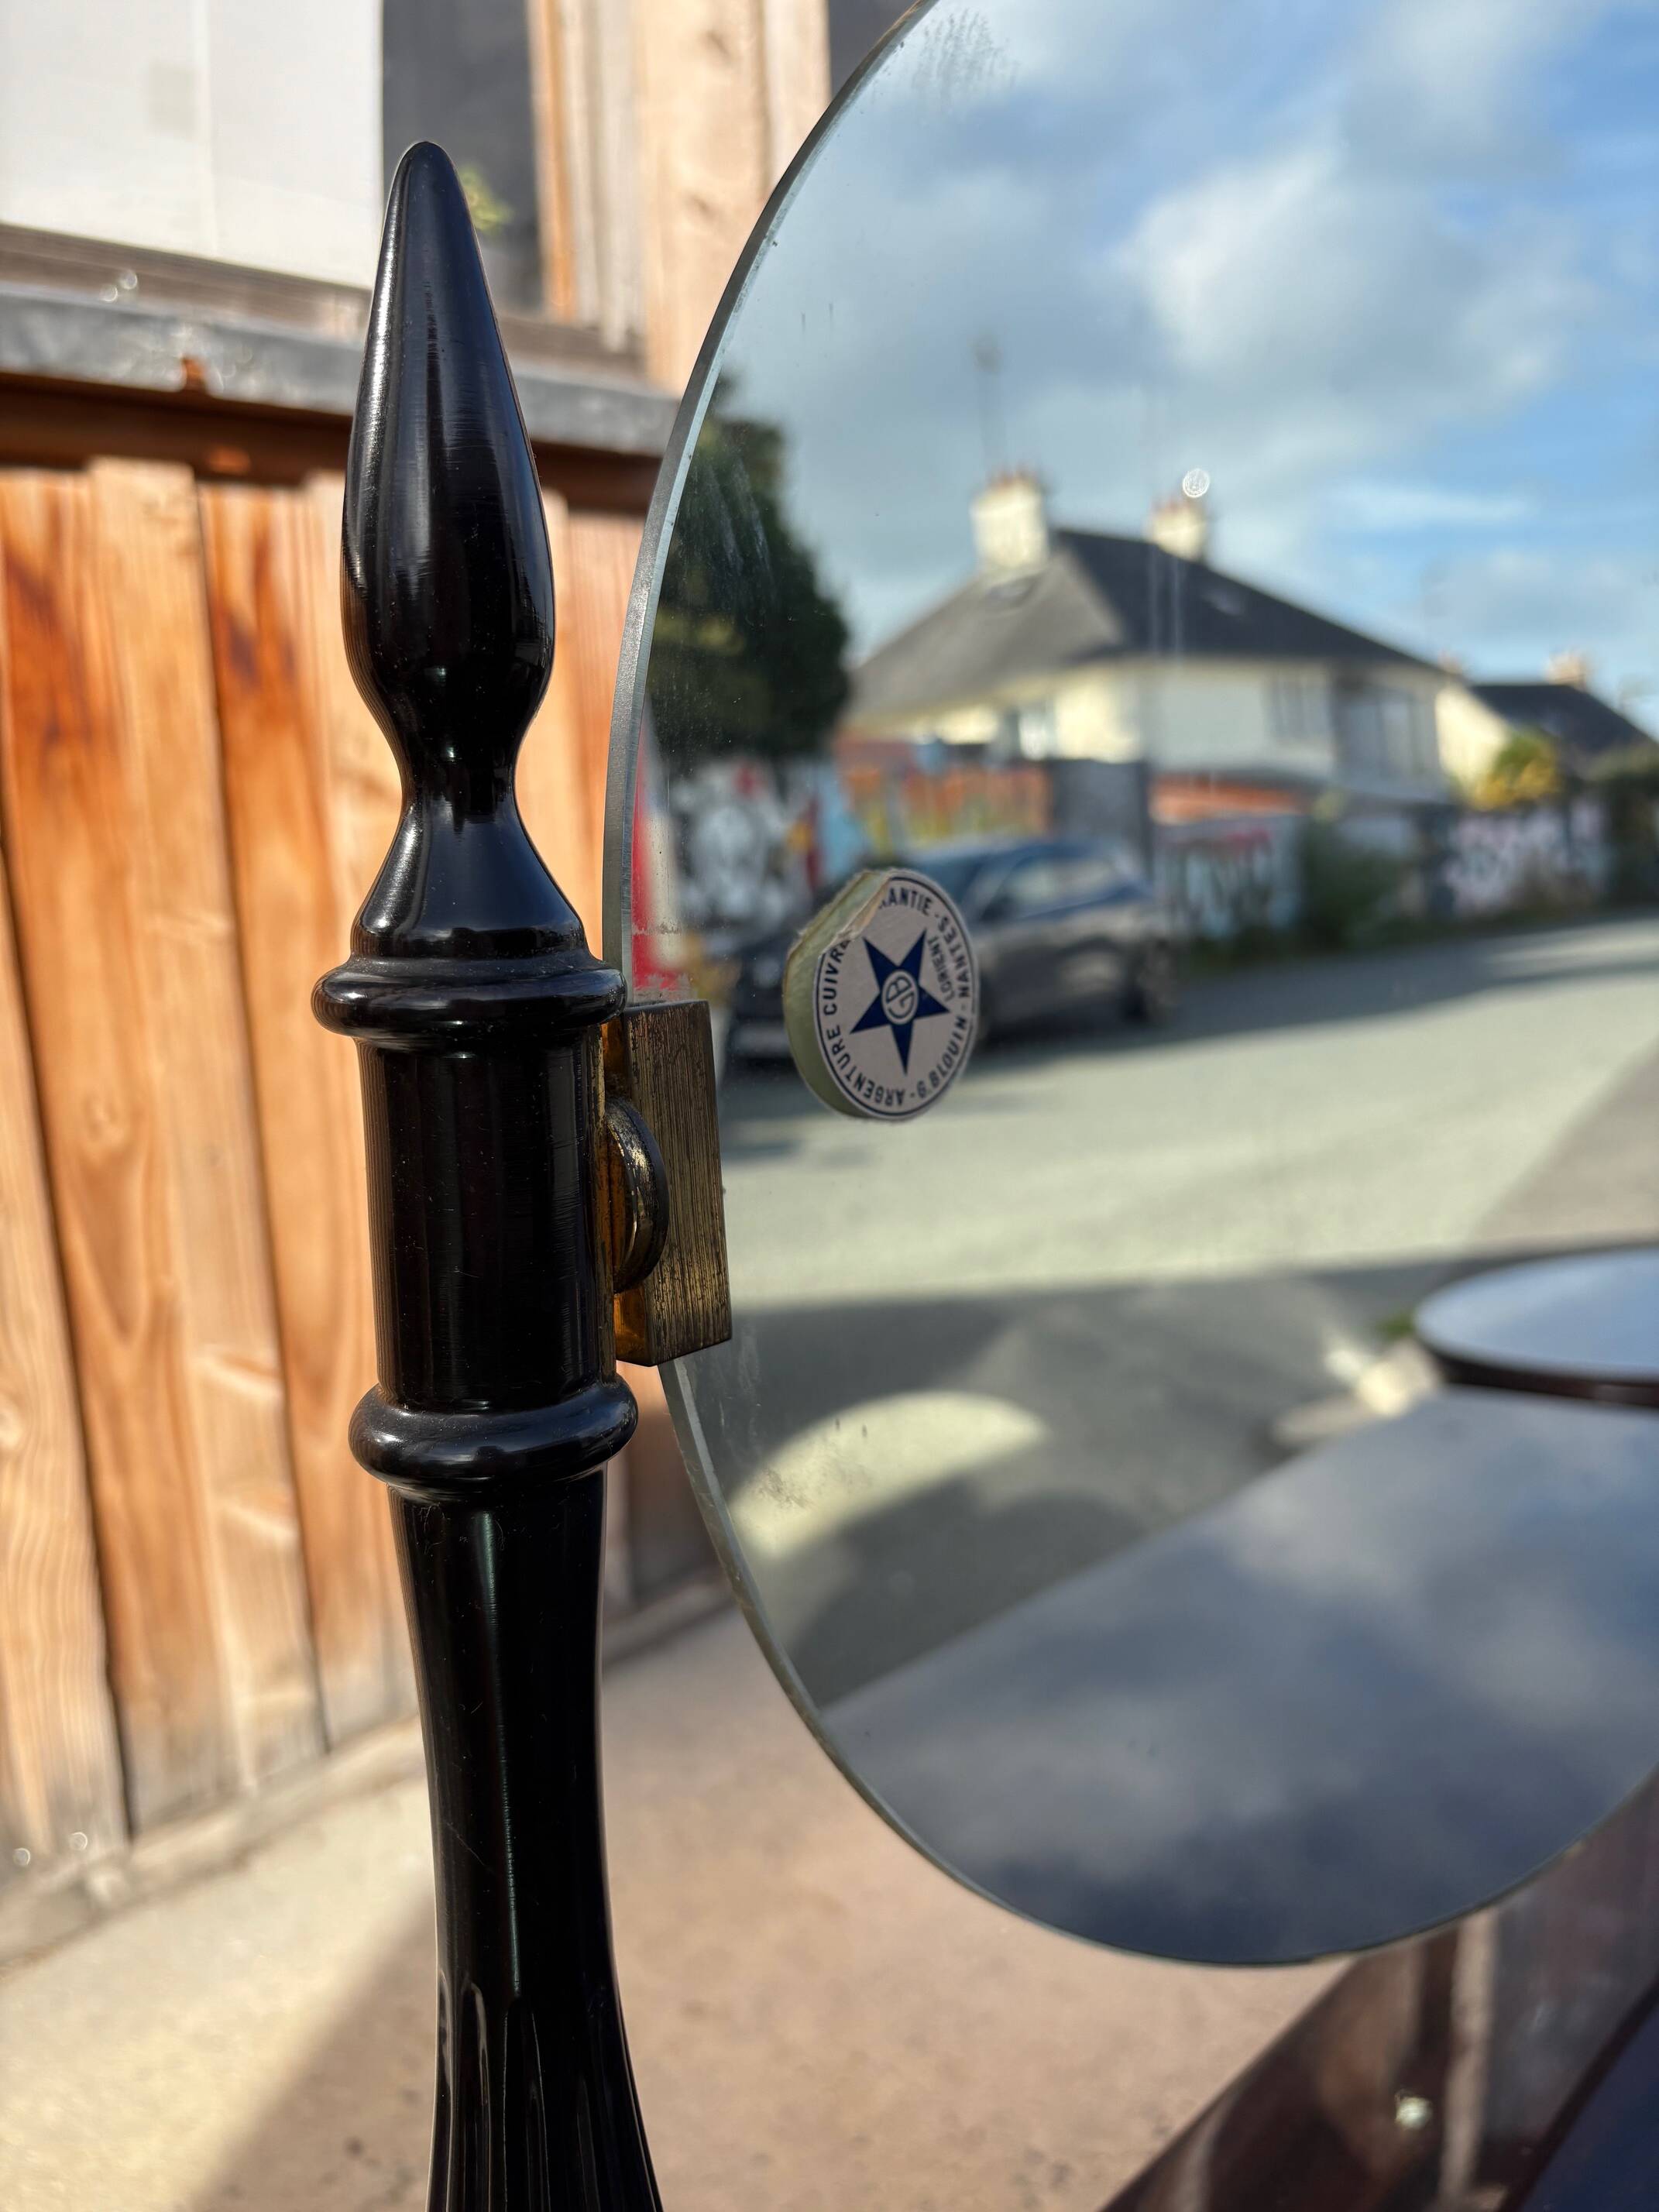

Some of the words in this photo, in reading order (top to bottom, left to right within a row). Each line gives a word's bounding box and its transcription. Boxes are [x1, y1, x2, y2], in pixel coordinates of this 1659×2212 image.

[928, 936, 955, 1001] LORIENT
[938, 916, 970, 998] NANTES
[826, 1024, 906, 1107] ARGENTURE
